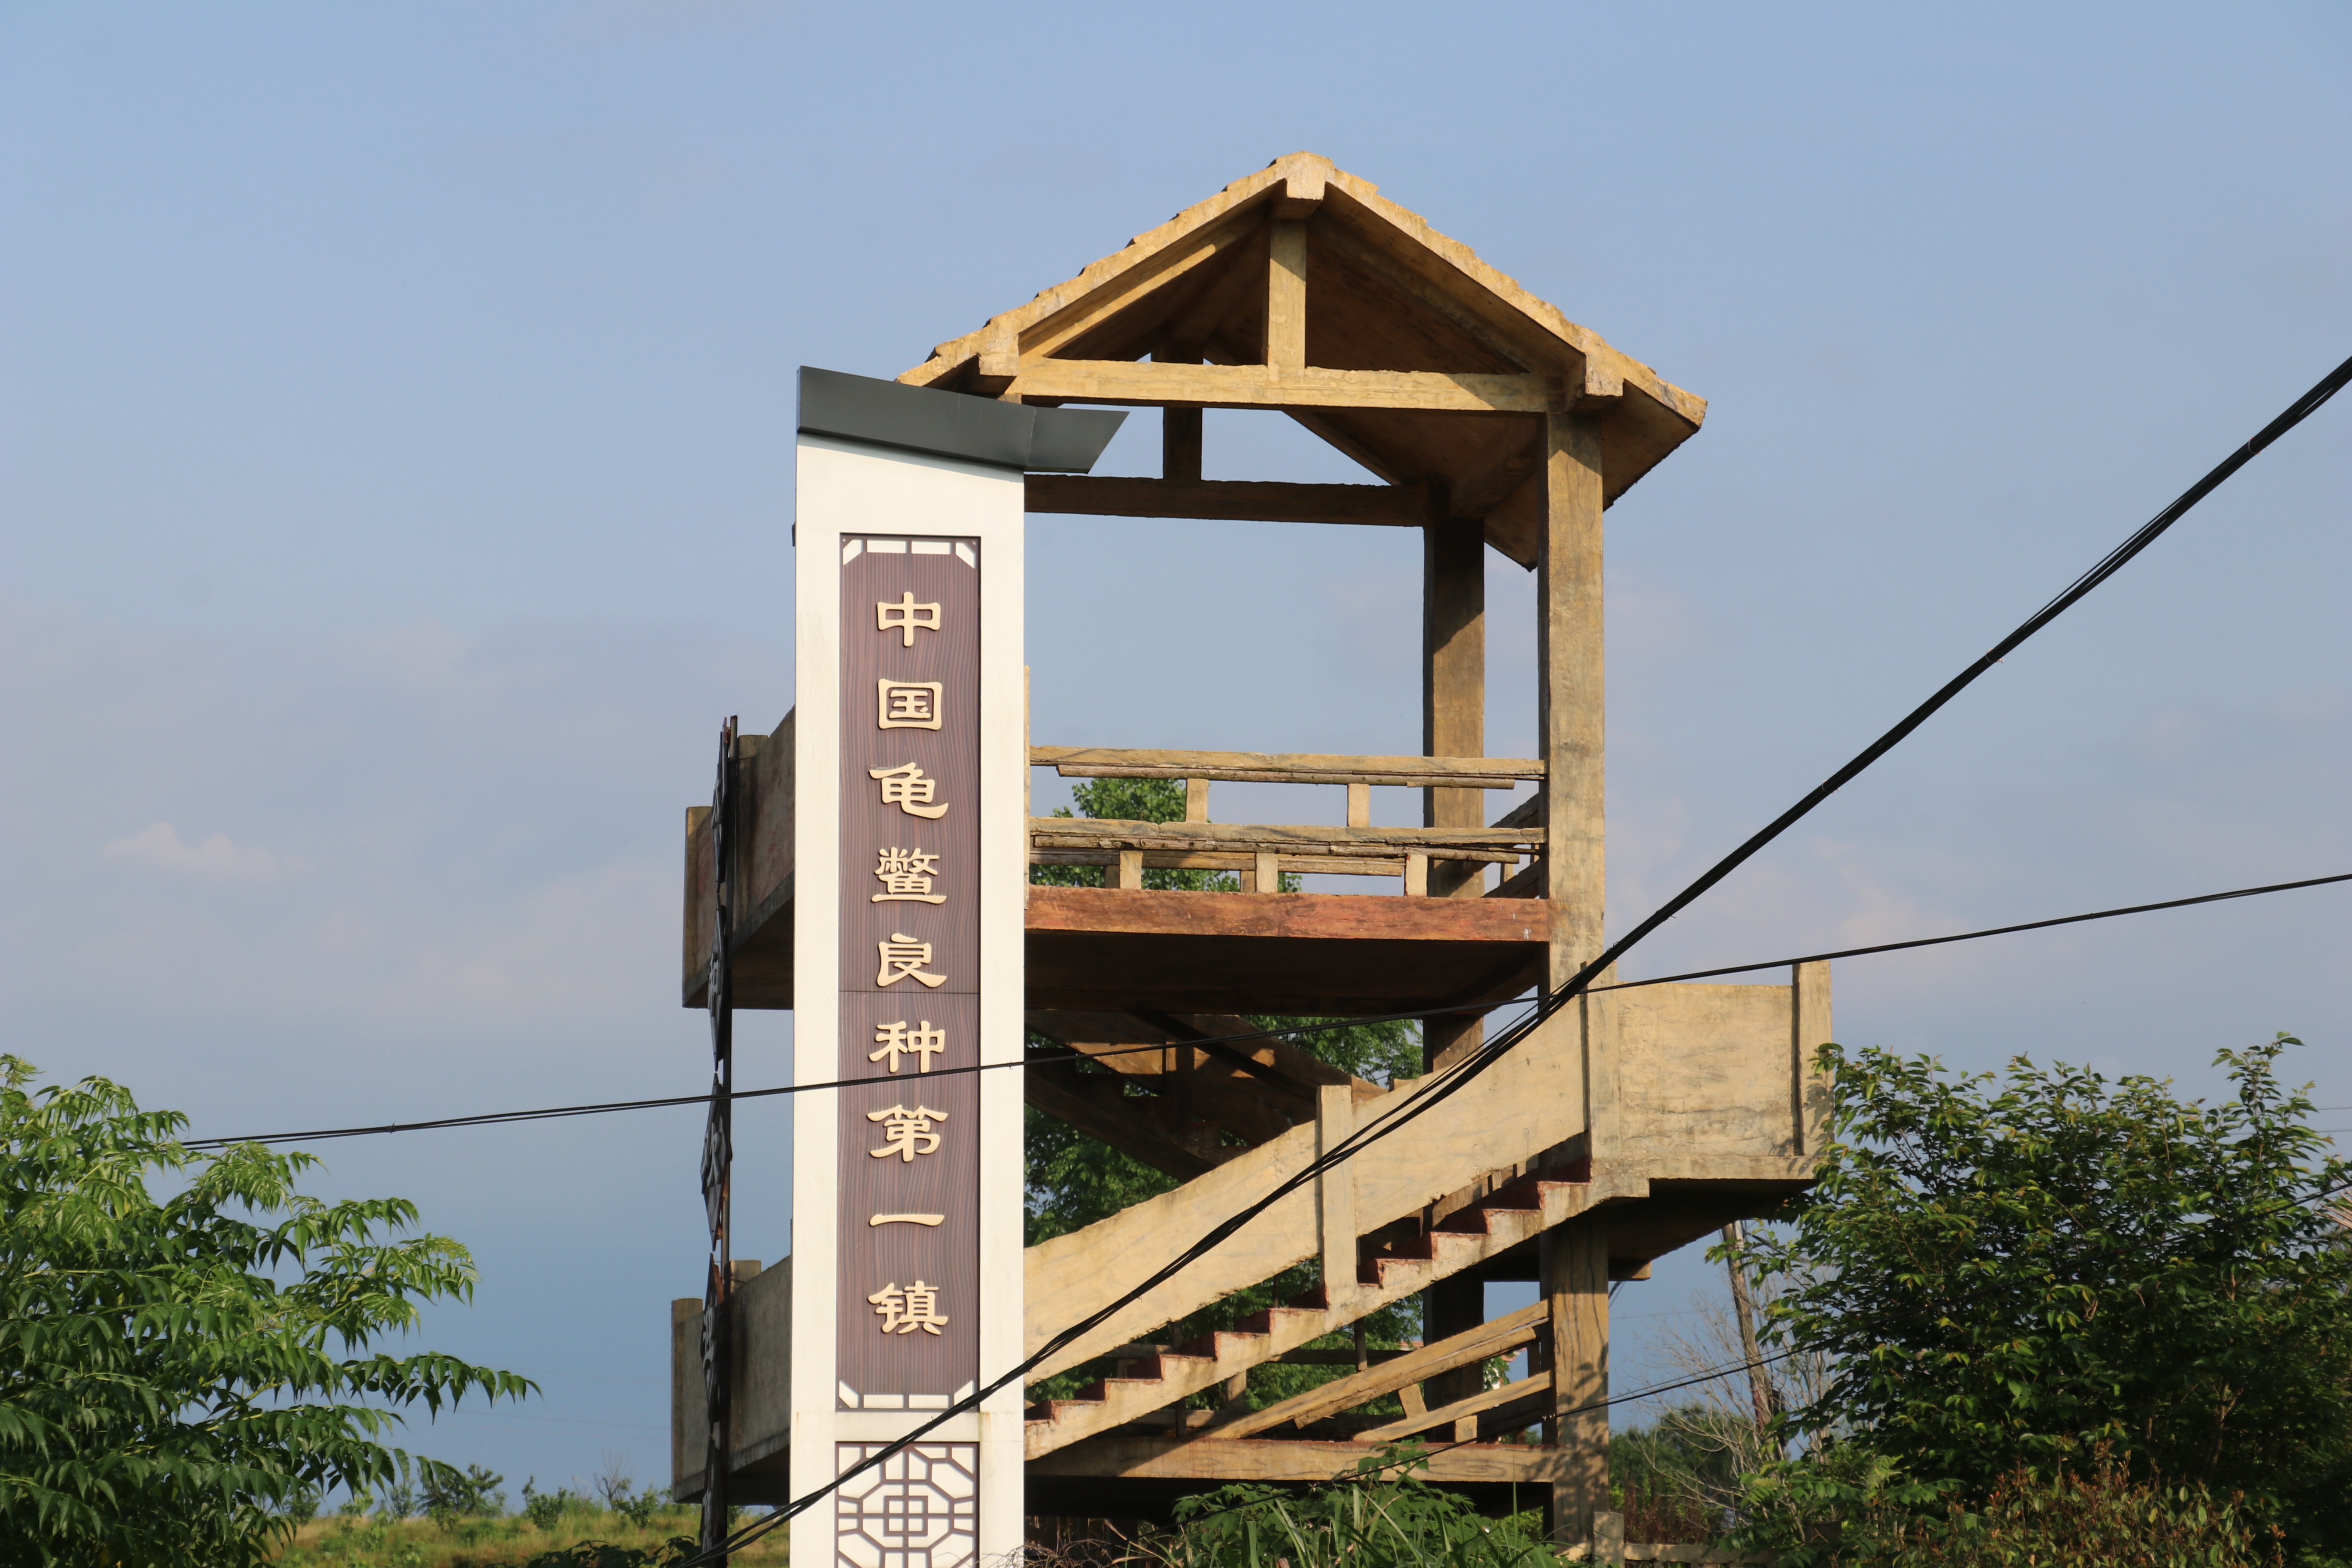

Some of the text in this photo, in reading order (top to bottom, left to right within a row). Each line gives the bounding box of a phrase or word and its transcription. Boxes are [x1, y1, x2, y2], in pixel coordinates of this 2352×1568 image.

[867, 591, 949, 1335] 中国龟鳖良种第一镇
